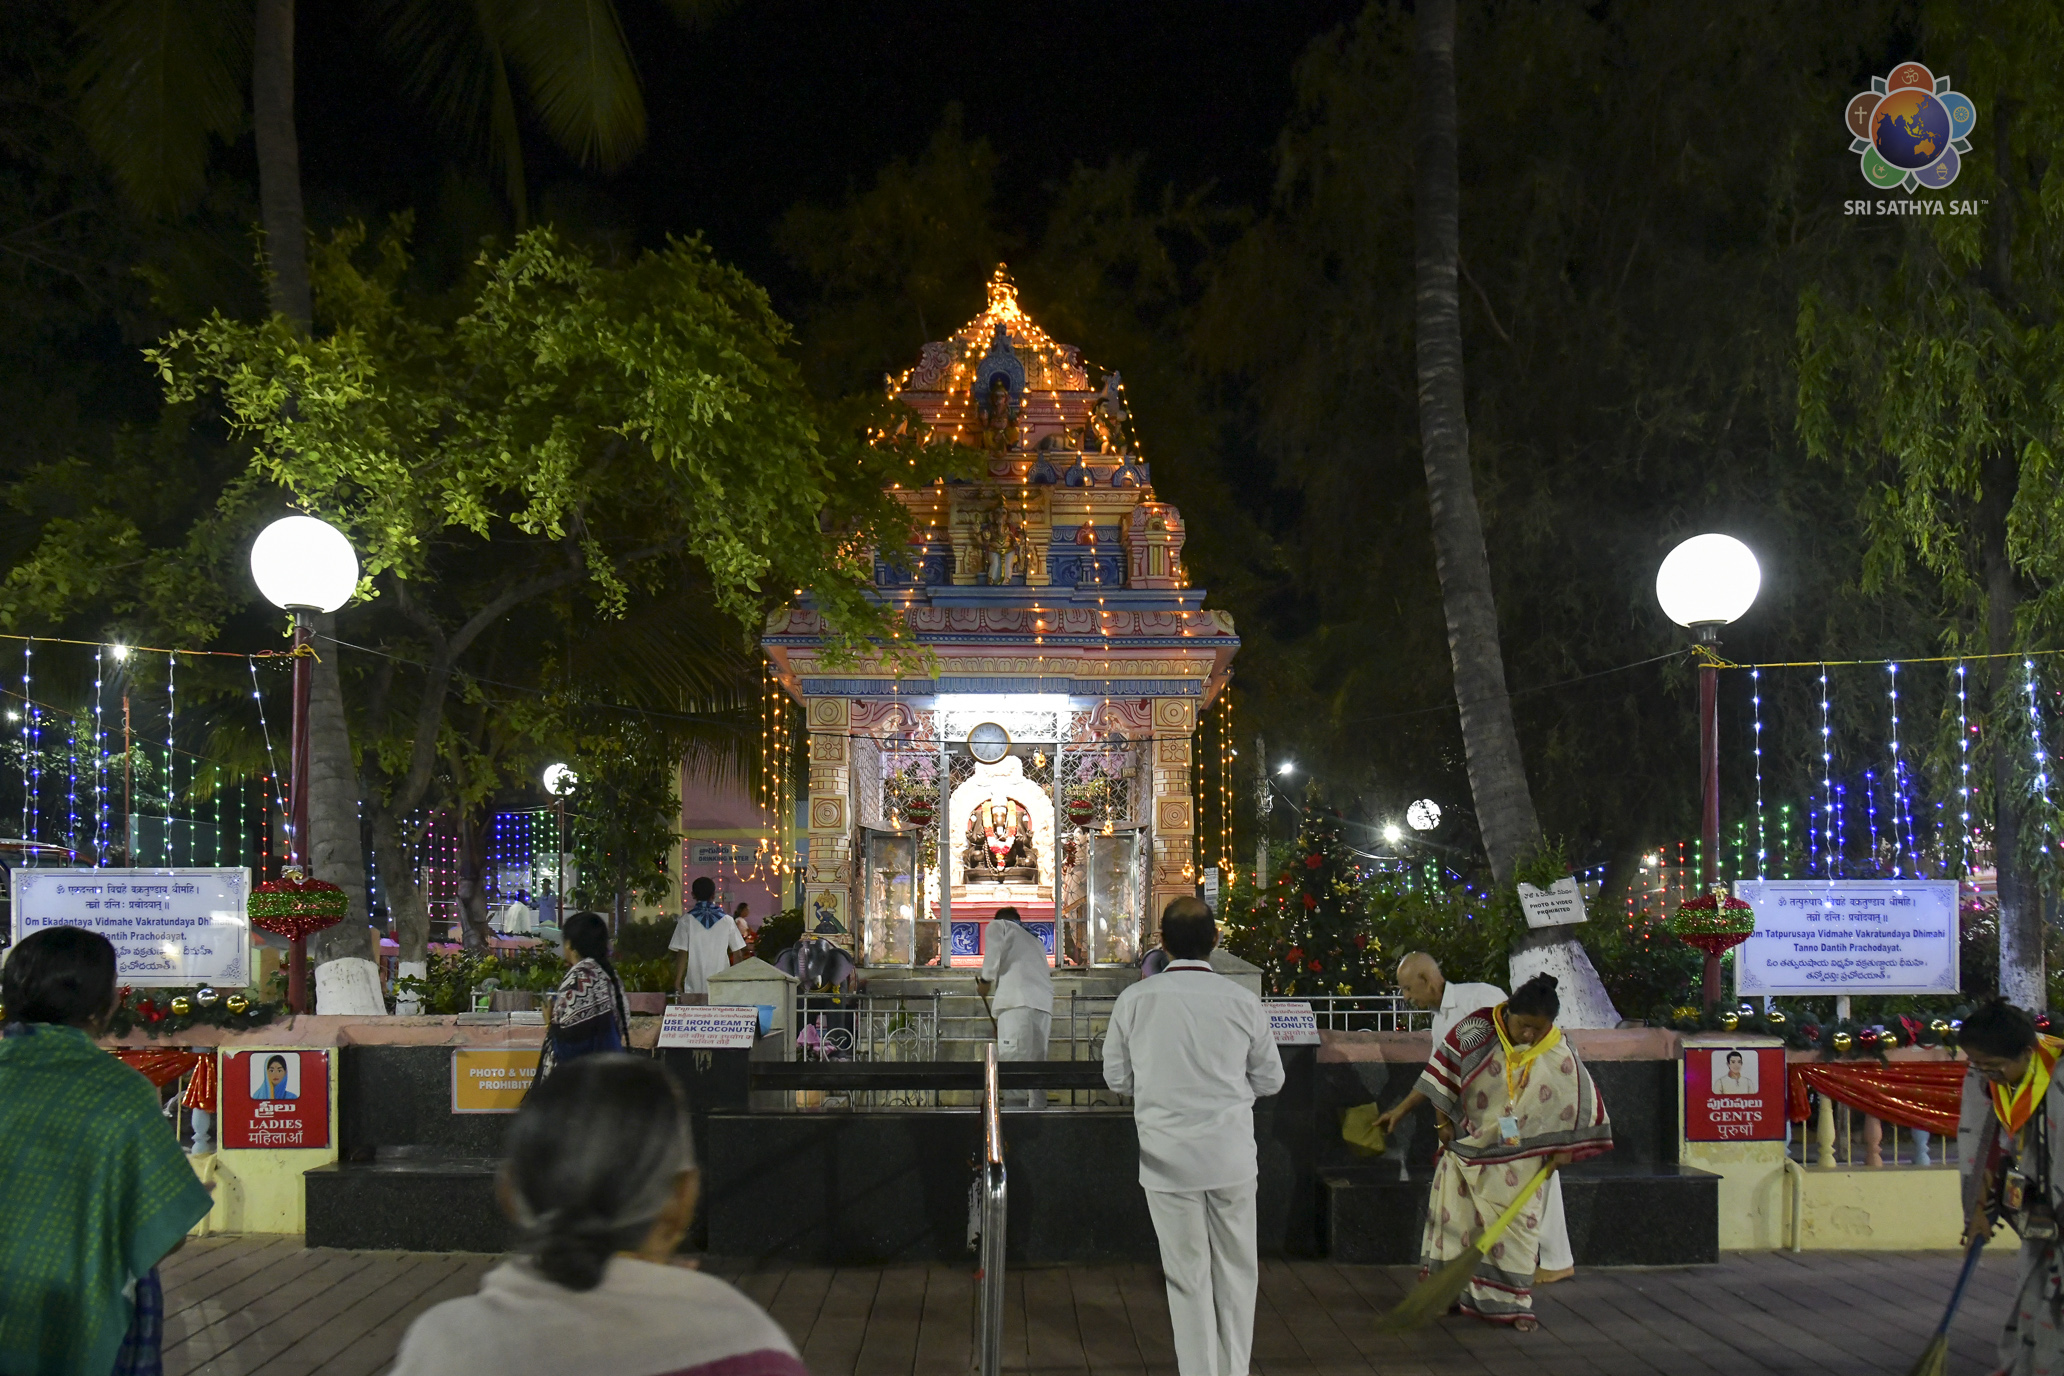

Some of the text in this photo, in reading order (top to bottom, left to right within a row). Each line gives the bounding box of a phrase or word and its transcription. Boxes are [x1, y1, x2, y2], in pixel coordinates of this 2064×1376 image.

[25, 918, 40, 926] Om
[42, 917, 92, 928] Ekadantaya
[95, 917, 133, 926] Vidmahe
[136, 917, 195, 928] Vakratundaya
[1766, 930, 1816, 940] Tatpurusaya
[1818, 930, 1853, 938] Vidmahe
[1856, 930, 1911, 940] Vakratundaya
[1913, 930, 1945, 938] Dhimahi
[1794, 943, 1902, 954] Tanno Dantih Prachodayat.
[470, 1068, 537, 1077] PHOTO & VID
[479, 1081, 532, 1090] PROHIBIT
[1710, 1111, 1762, 1121] GENTS
[250, 1120, 302, 1128] LADIES
